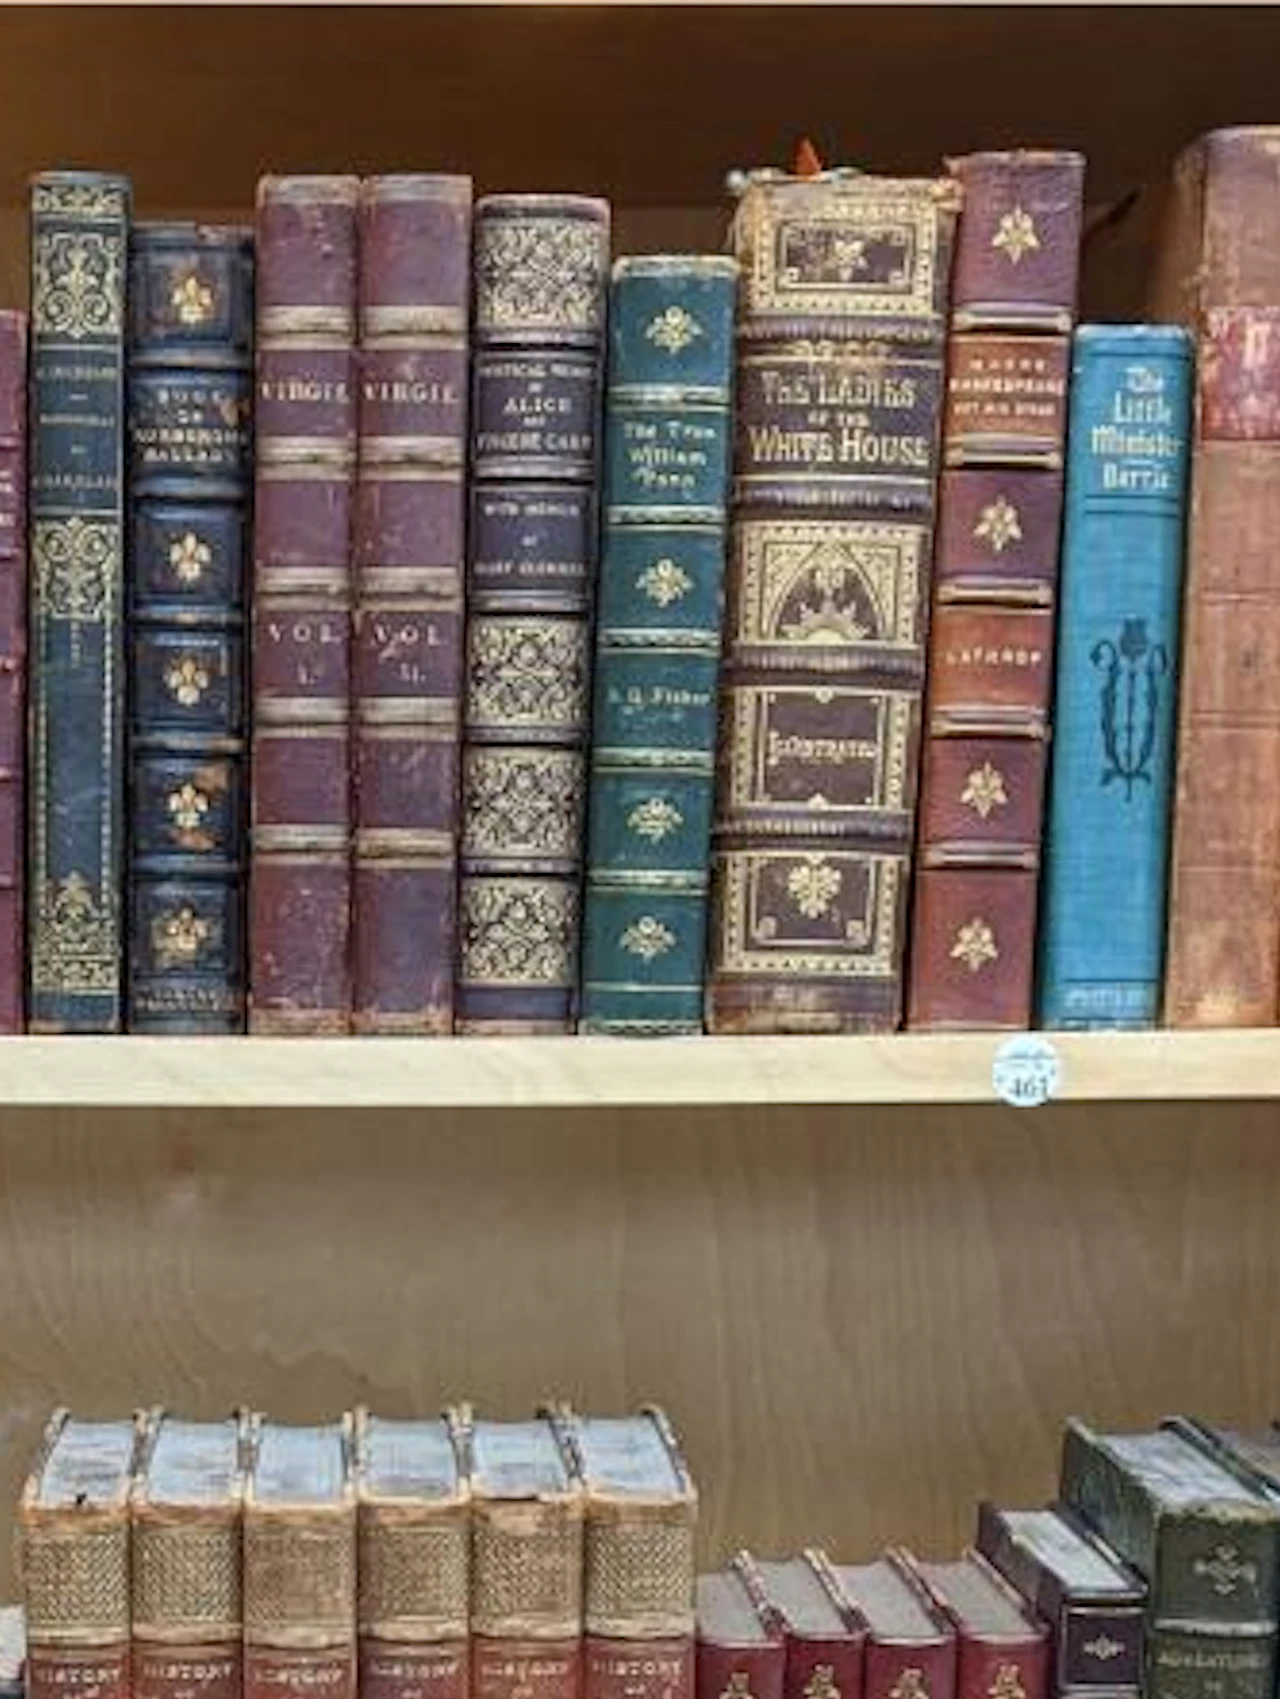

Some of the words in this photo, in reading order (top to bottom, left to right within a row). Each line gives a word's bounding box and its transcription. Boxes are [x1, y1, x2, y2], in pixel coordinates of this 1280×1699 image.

[816, 372, 918, 407] LADIES
[1126, 364, 1165, 392] The
[260, 381, 350, 403] VIRGIL
[363, 381, 458, 404] VIRGIL
[502, 396, 573, 415] ALICE
[1114, 391, 1174, 428] Little
[749, 427, 836, 463] WHITE
[839, 429, 929, 467] HOUSE
[1092, 423, 1182, 459] Minister
[627, 445, 709, 468] William
[1102, 460, 1169, 489] Barrie
[268, 622, 342, 643] VOL
[373, 623, 448, 647] VOL
